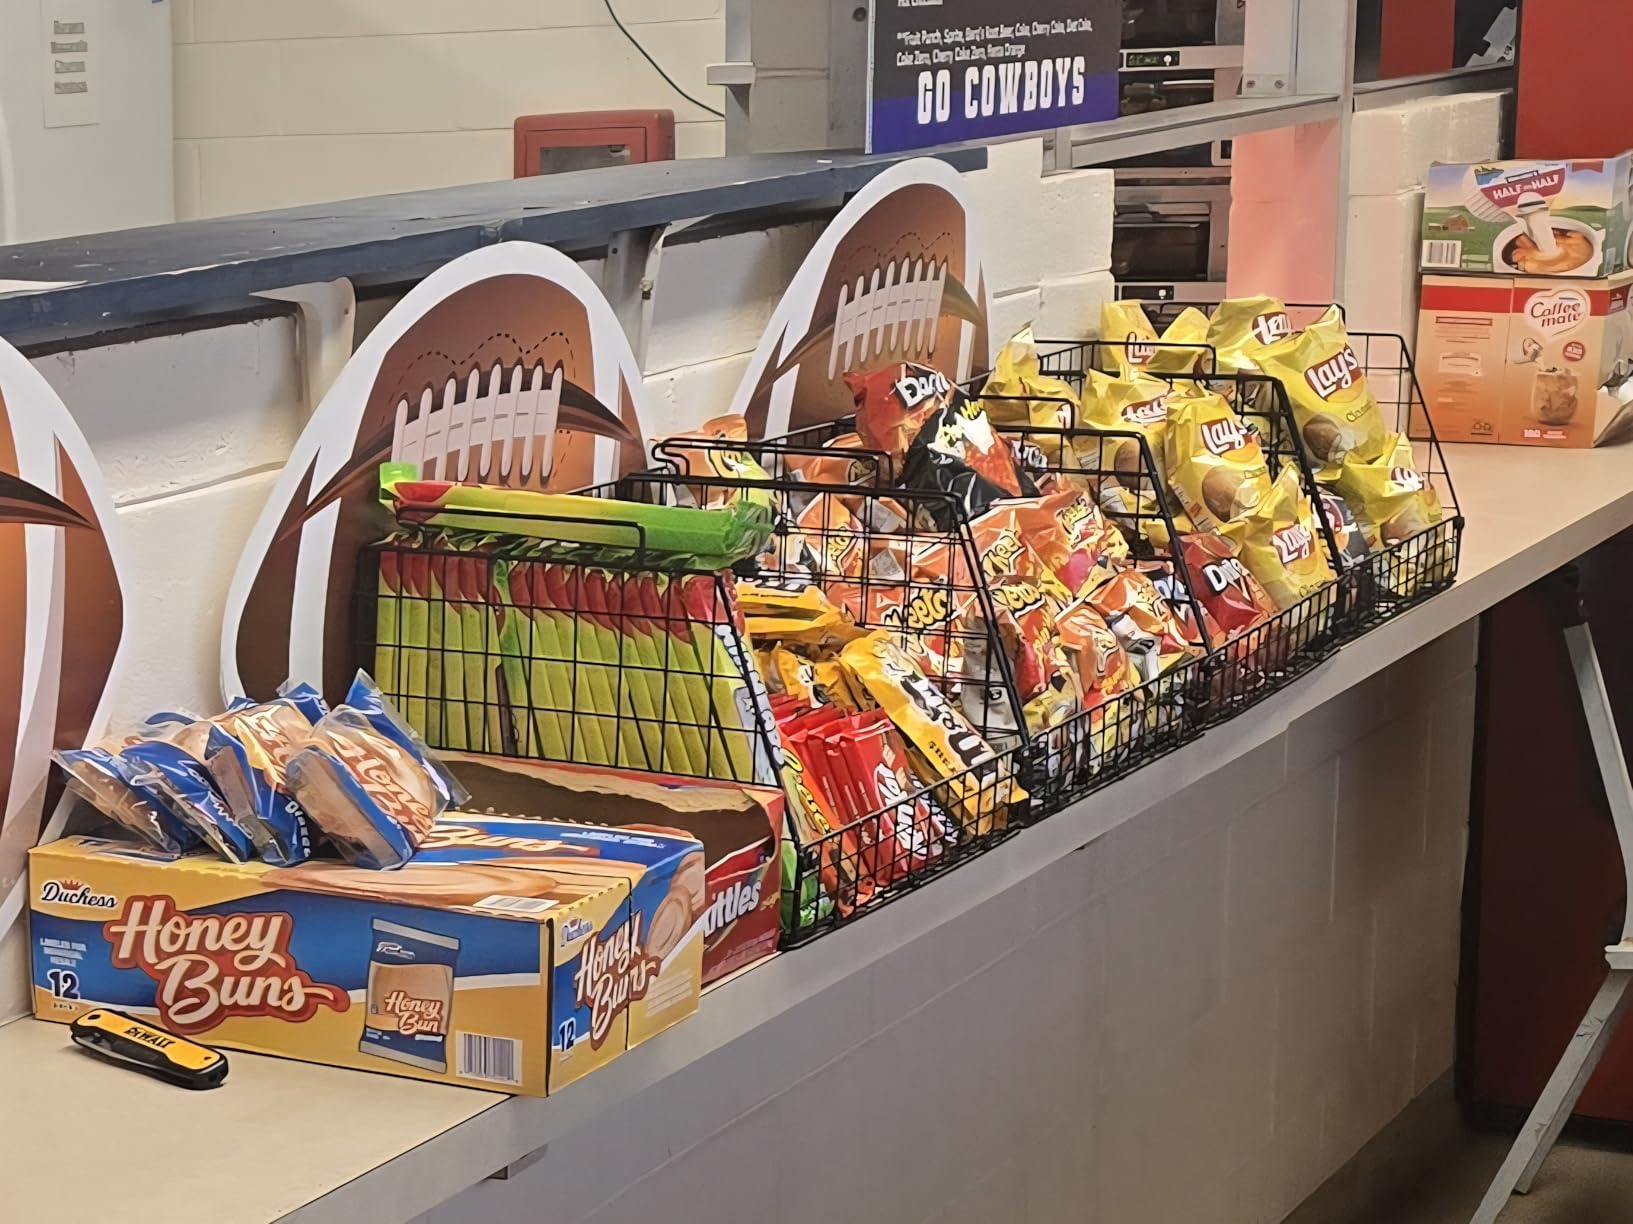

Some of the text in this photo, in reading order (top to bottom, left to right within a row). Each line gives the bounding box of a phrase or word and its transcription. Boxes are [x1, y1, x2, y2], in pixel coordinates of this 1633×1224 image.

[917, 55, 1086, 125] GO COWBOYS
[1492, 184, 1523, 200] HALF
[1531, 174, 1560, 190] HALF
[1530, 302, 1581, 319] Coffee
[1541, 312, 1582, 328] mate
[41, 880, 118, 909] Duchess
[110, 900, 286, 971] Honey
[574, 909, 642, 1002] Honey
[47, 968, 81, 1000] 12
[154, 953, 334, 1025] Buns
[588, 960, 657, 1040] Buns
[384, 991, 442, 1019] Honey
[397, 1011, 439, 1035] Bun
[559, 1017, 576, 1052] 12
